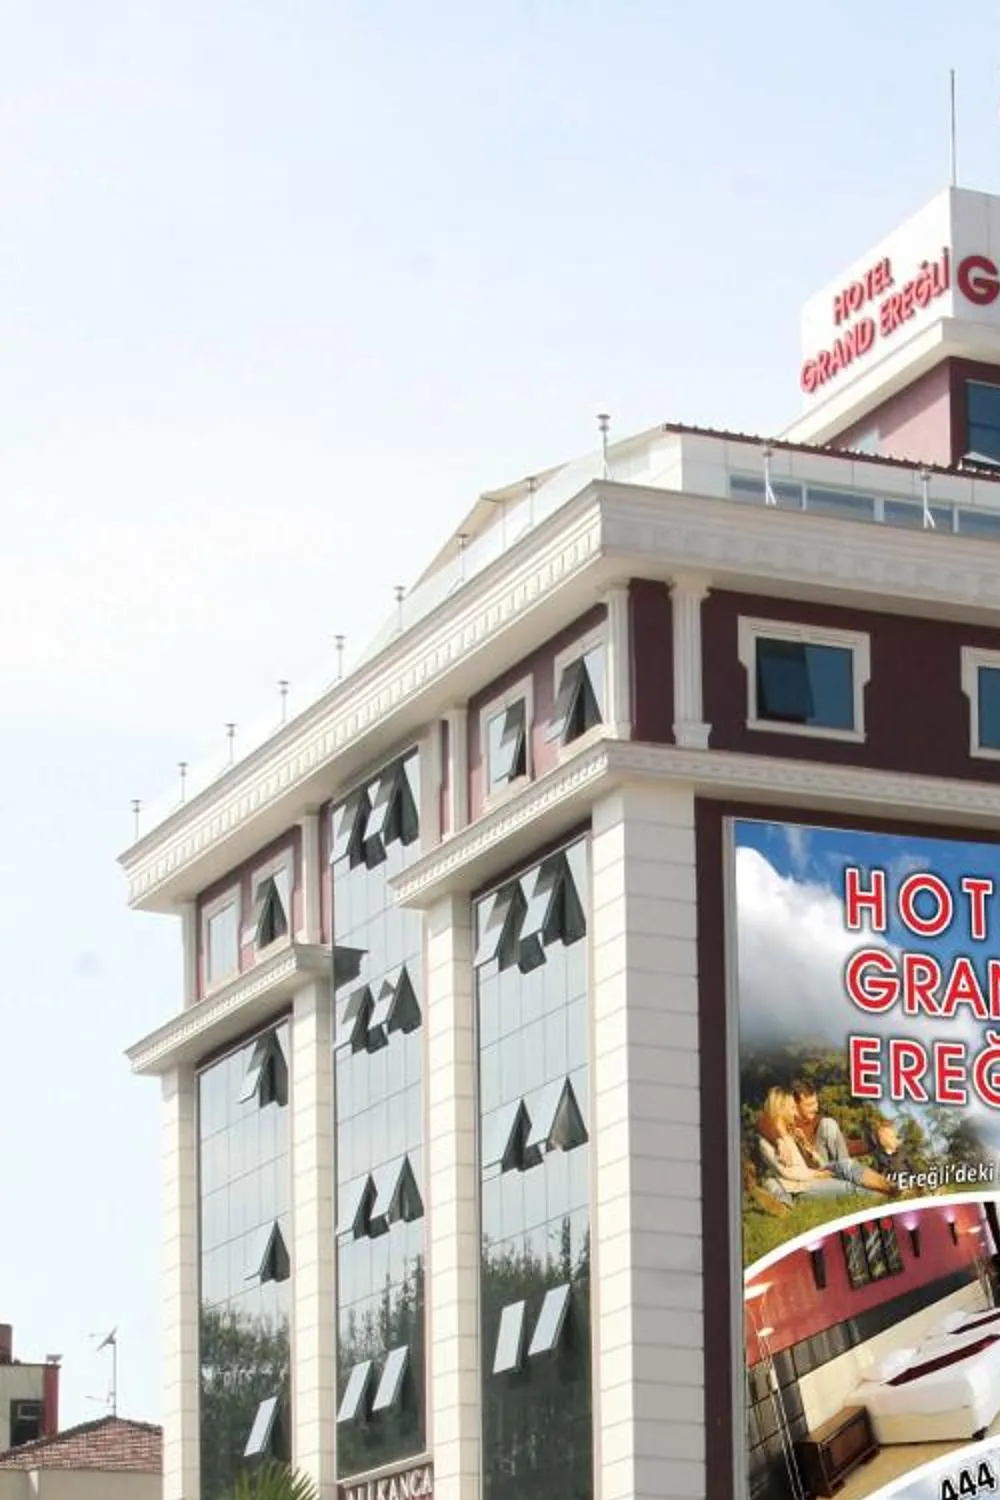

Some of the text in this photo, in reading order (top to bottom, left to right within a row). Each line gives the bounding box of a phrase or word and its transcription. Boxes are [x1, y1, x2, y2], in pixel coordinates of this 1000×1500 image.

[800, 245, 950, 394] GRAND EREĞLİ
[833, 256, 895, 326] HOTEL
